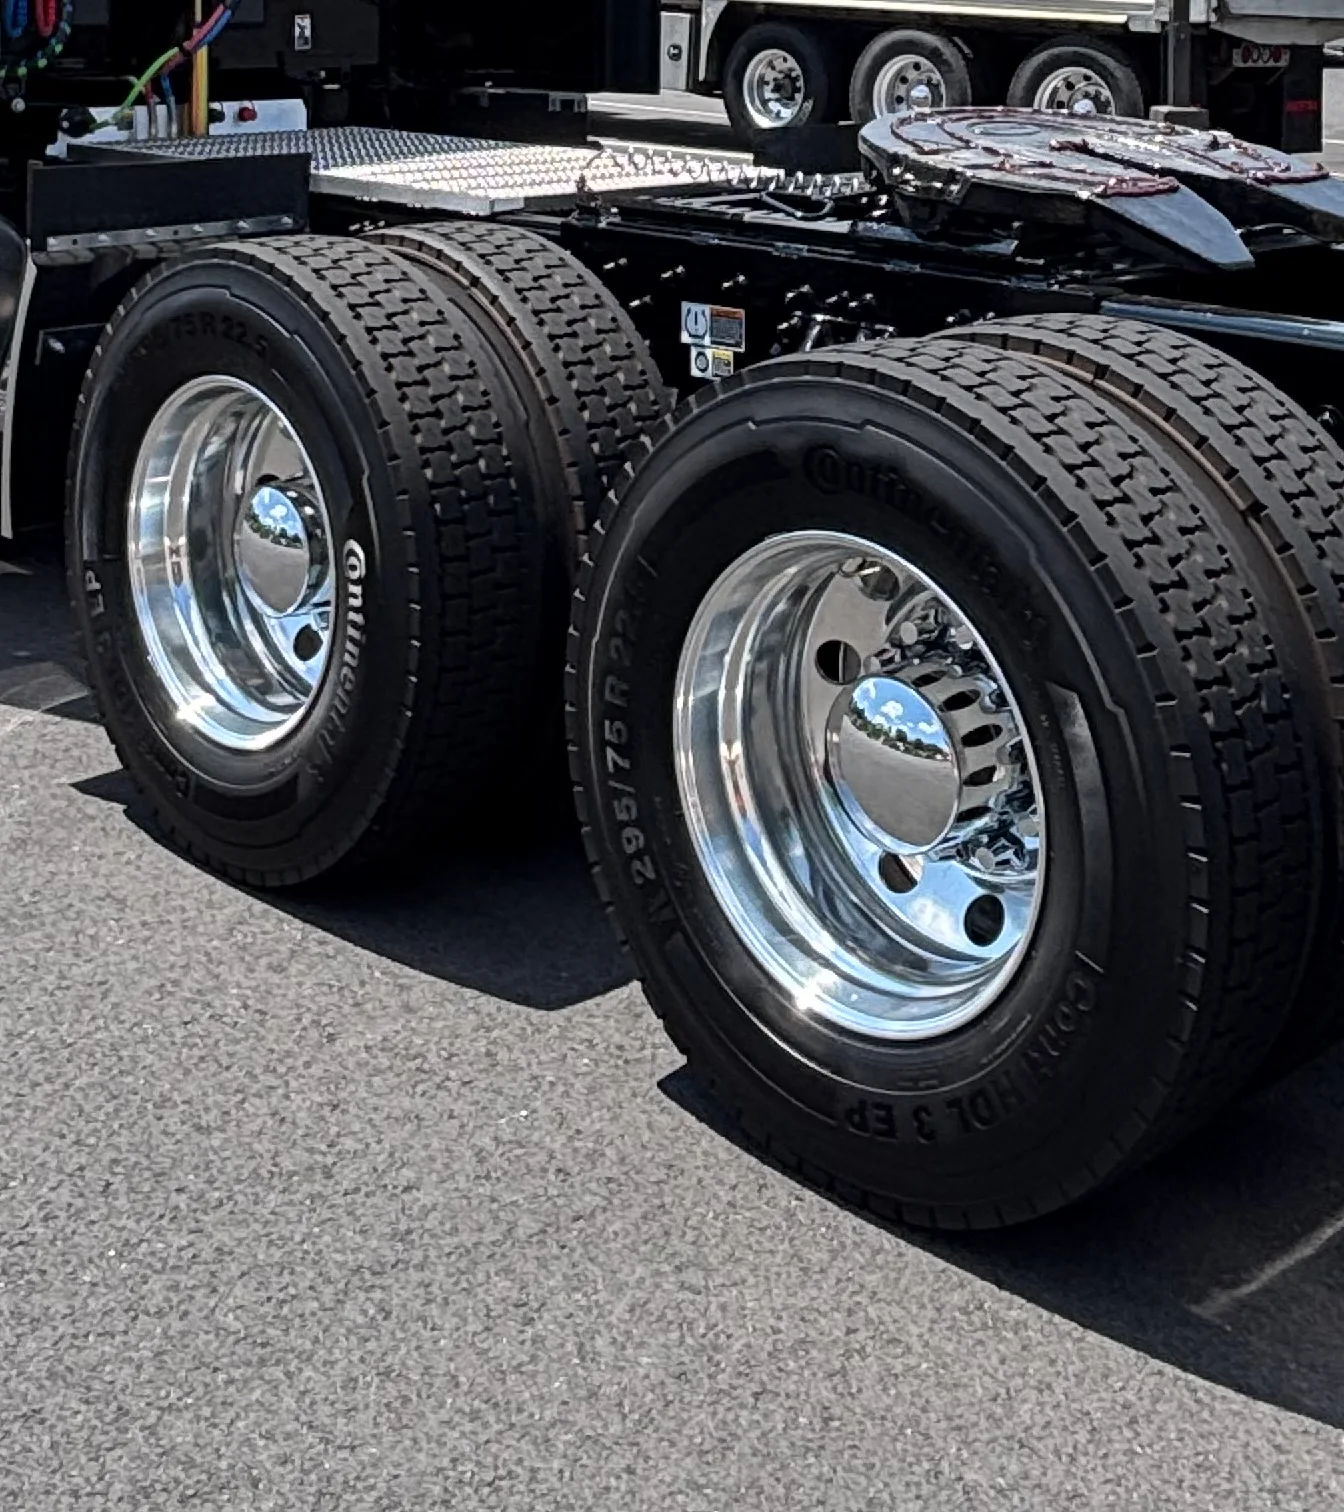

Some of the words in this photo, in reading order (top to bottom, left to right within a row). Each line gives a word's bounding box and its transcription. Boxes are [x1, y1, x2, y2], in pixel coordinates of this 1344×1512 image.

[317, 538, 368, 765] Continental
[603, 674, 630, 709] R
[603, 718, 657, 886] 295/75
[844, 1099, 898, 1144] EP
[912, 1105, 937, 1145] 3
[946, 1070, 1025, 1135] HDL
